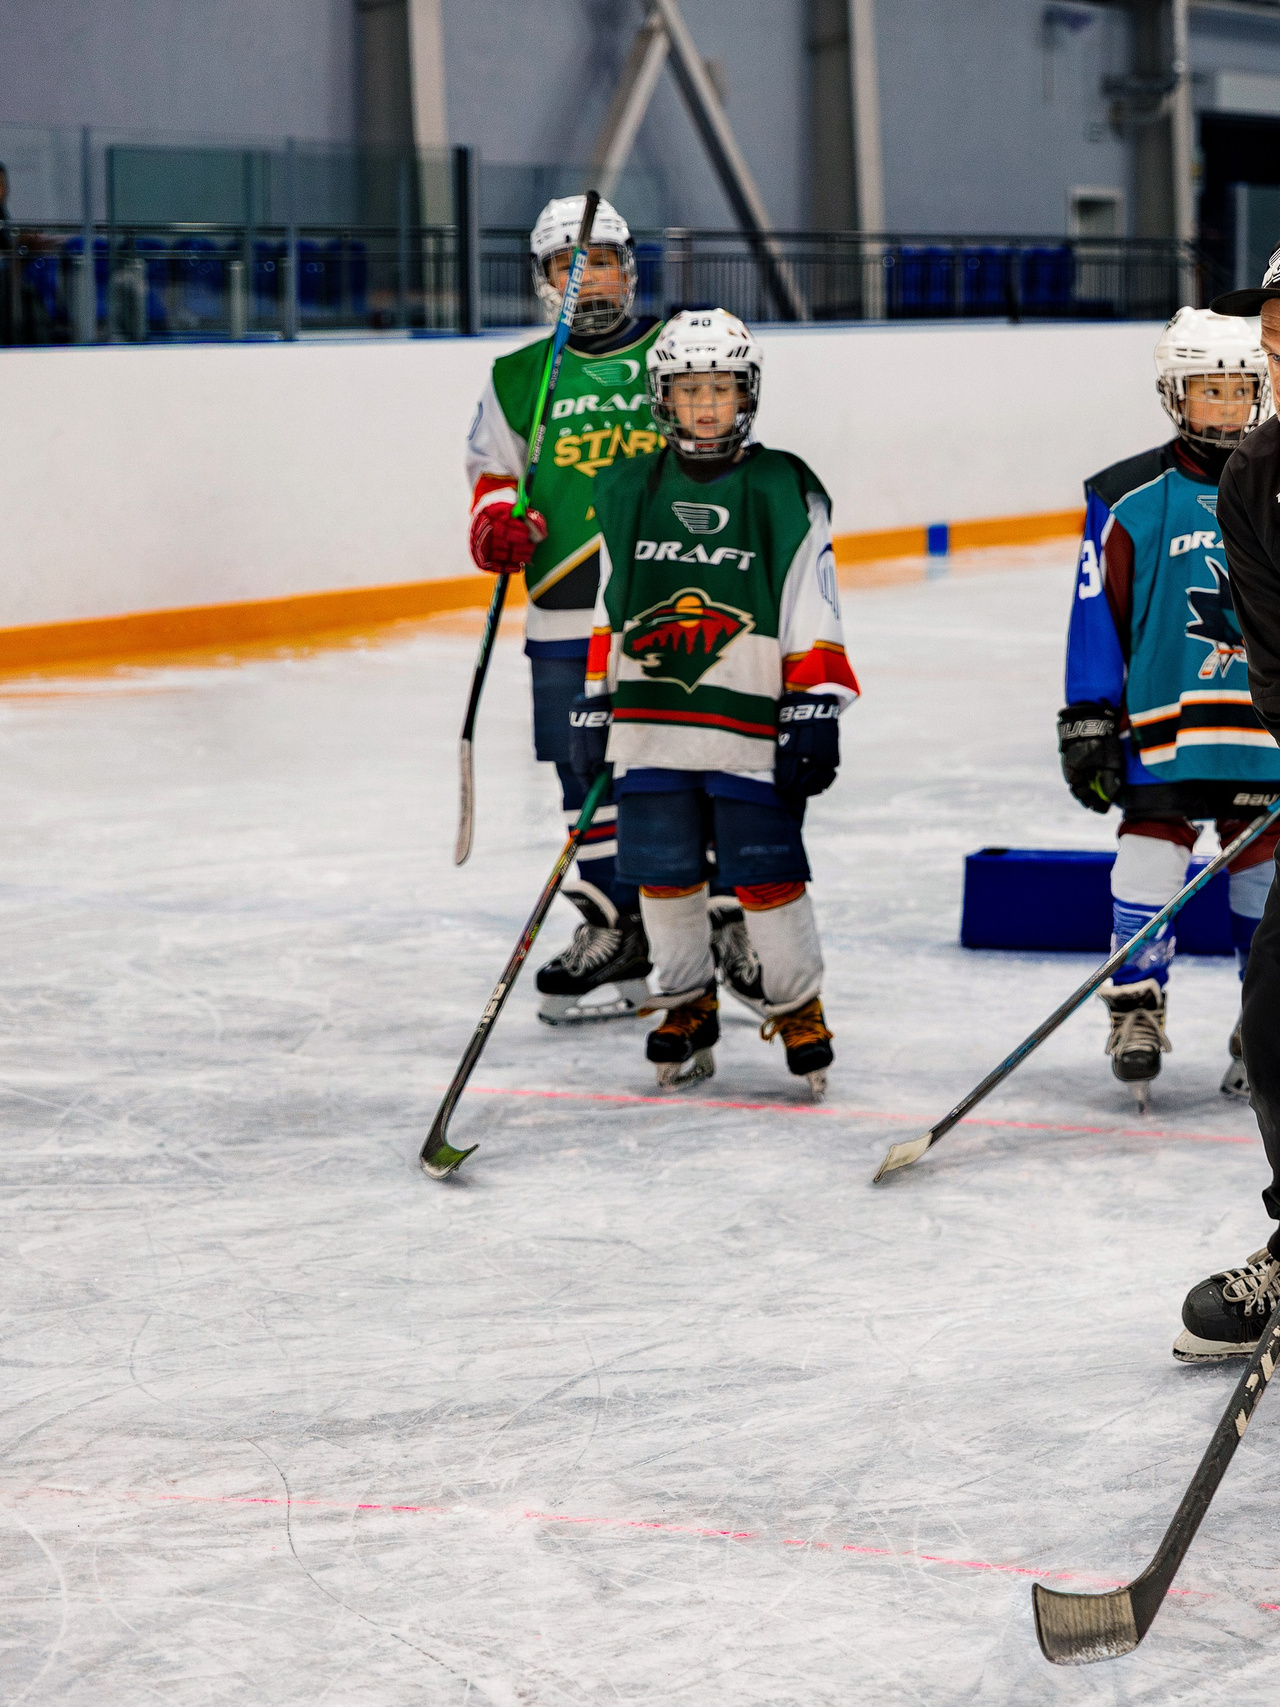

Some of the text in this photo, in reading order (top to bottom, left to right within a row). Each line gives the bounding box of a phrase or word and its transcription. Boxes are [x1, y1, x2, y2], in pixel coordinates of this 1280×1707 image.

[551, 393, 659, 420] DRAF
[554, 424, 667, 475] STAR
[634, 540, 756, 571] DRAFT
[779, 703, 839, 723] BAU
[1060, 719, 1115, 740] UER
